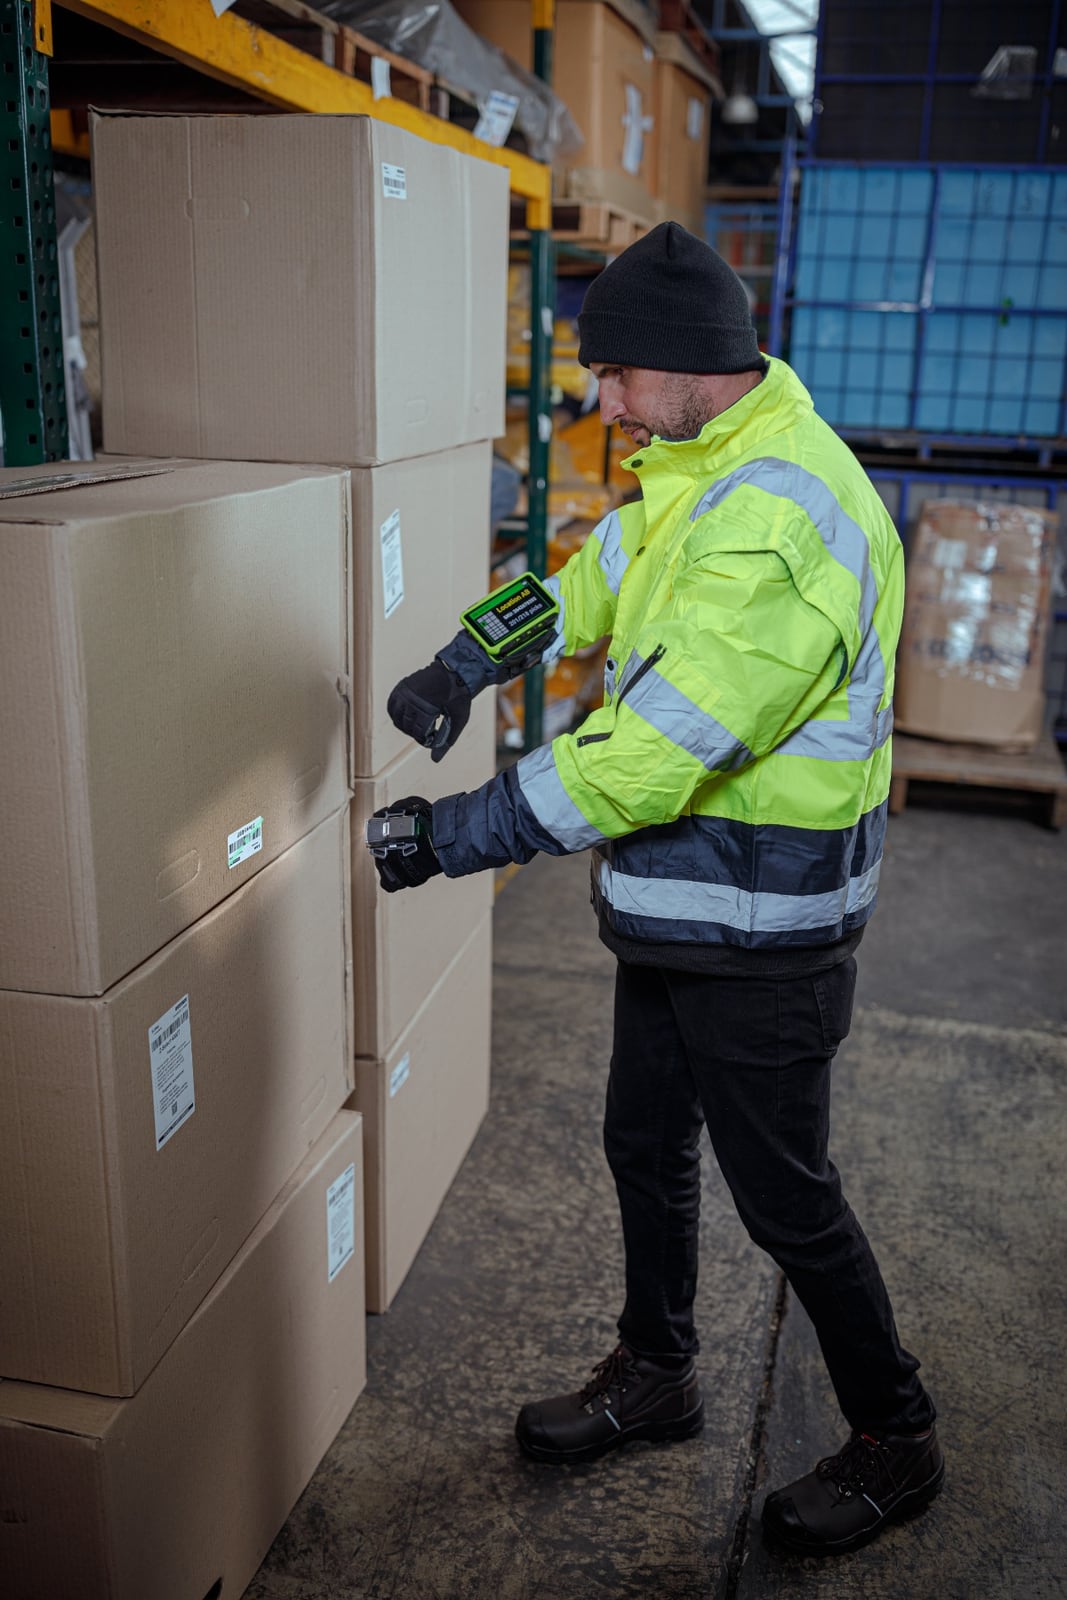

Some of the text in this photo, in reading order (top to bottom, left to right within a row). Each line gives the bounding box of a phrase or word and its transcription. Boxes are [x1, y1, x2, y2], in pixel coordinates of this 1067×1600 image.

[495, 595, 522, 613] Location
[520, 588, 531, 598] AB
[529, 603, 543, 615] picks
